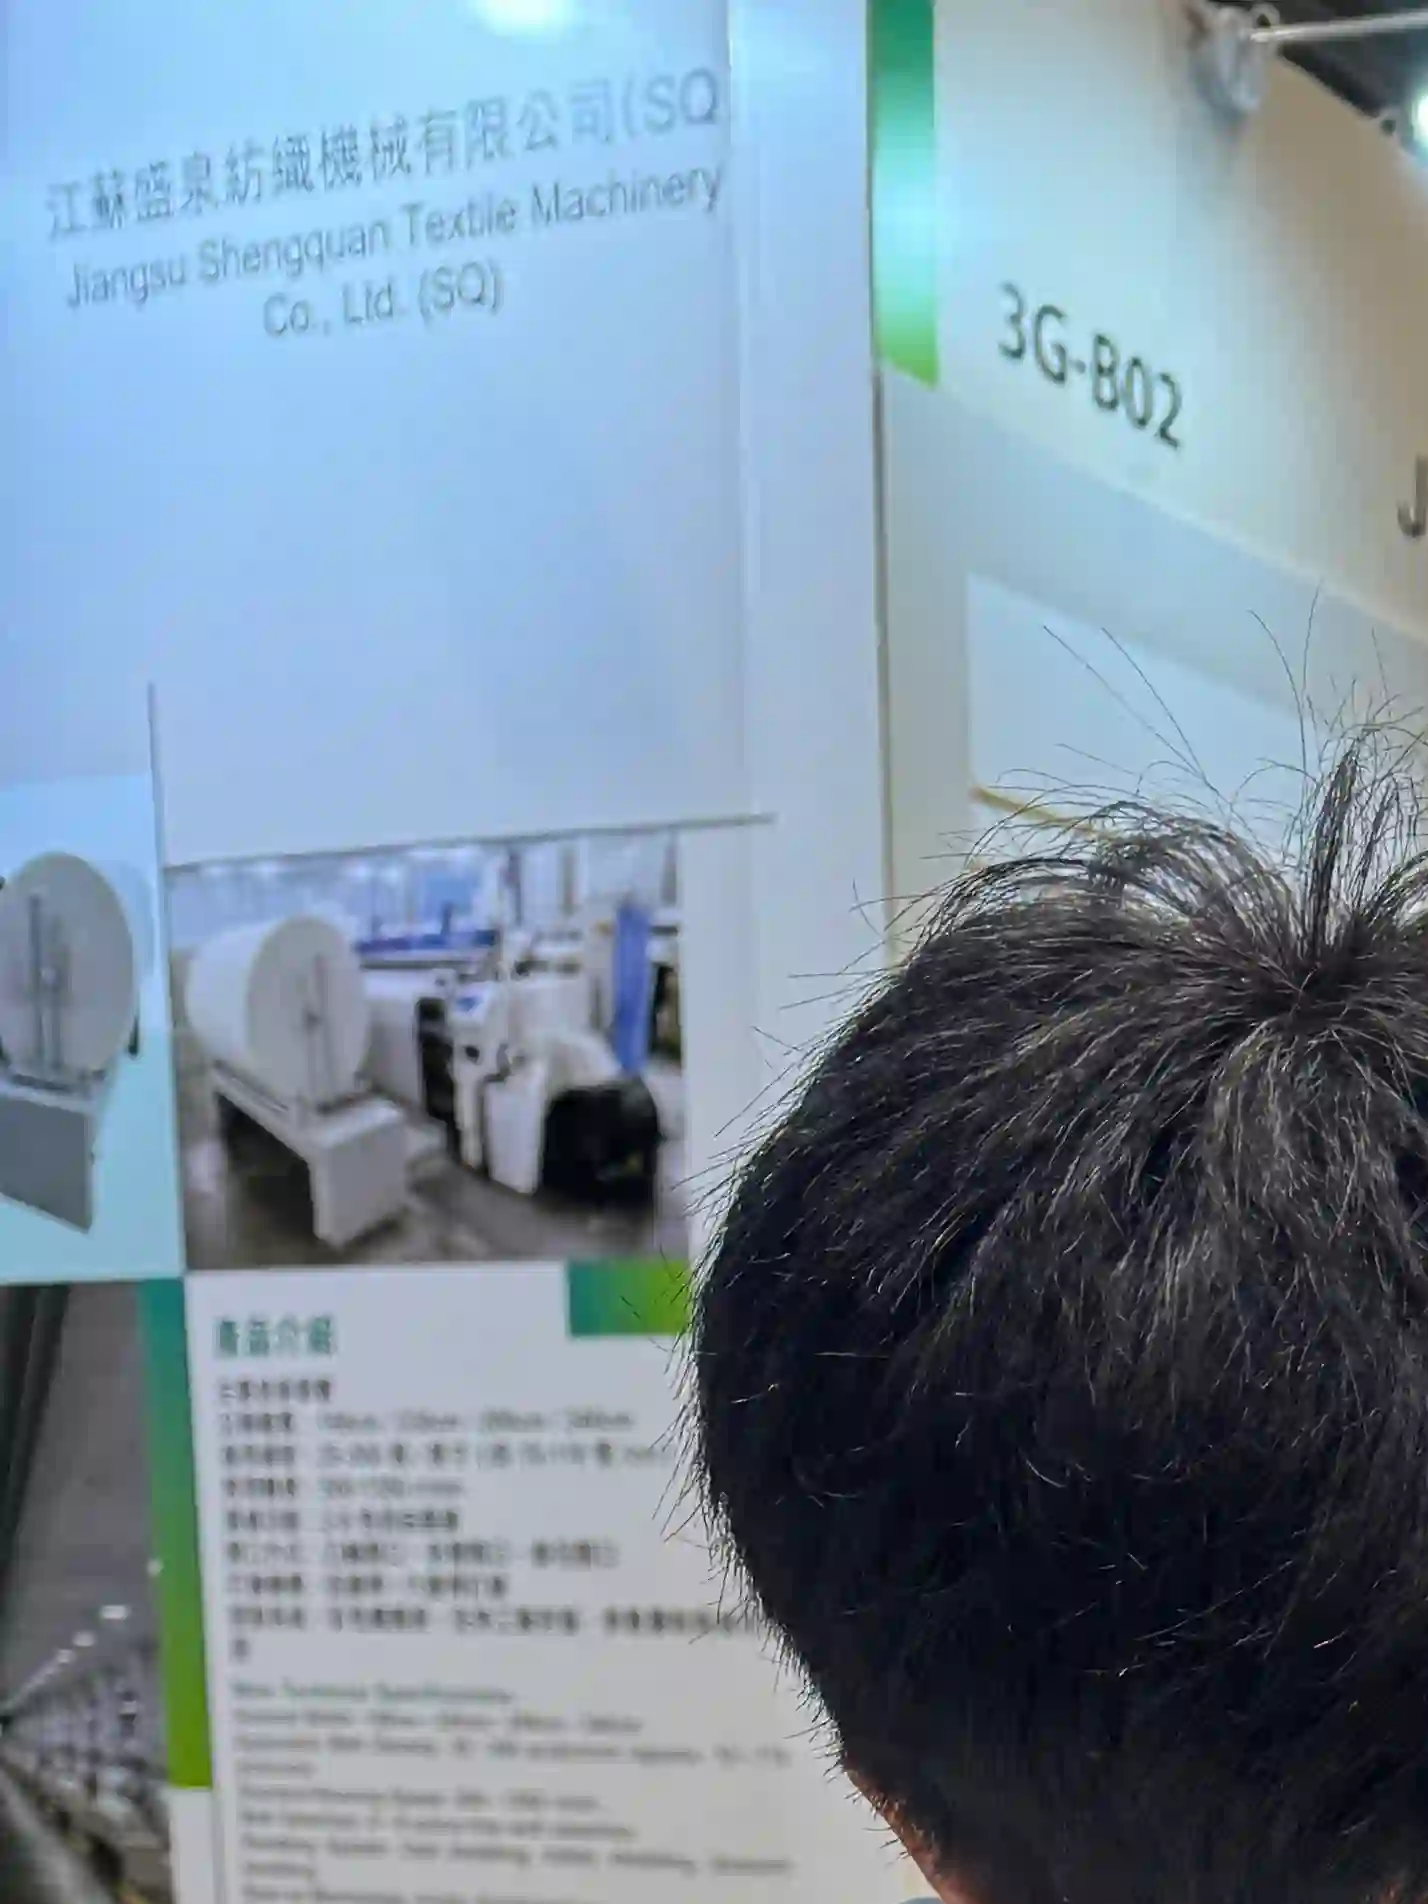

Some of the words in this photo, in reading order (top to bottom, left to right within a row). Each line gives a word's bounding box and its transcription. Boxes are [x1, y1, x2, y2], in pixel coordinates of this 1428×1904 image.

[66, 250, 186, 311] Jiangsu
[198, 211, 391, 282] Shengquan
[400, 191, 517, 246] Textile
[531, 160, 724, 227] Machinery
[418, 257, 504, 319] (SQ)
[994, 280, 1185, 450] 3G-B02
